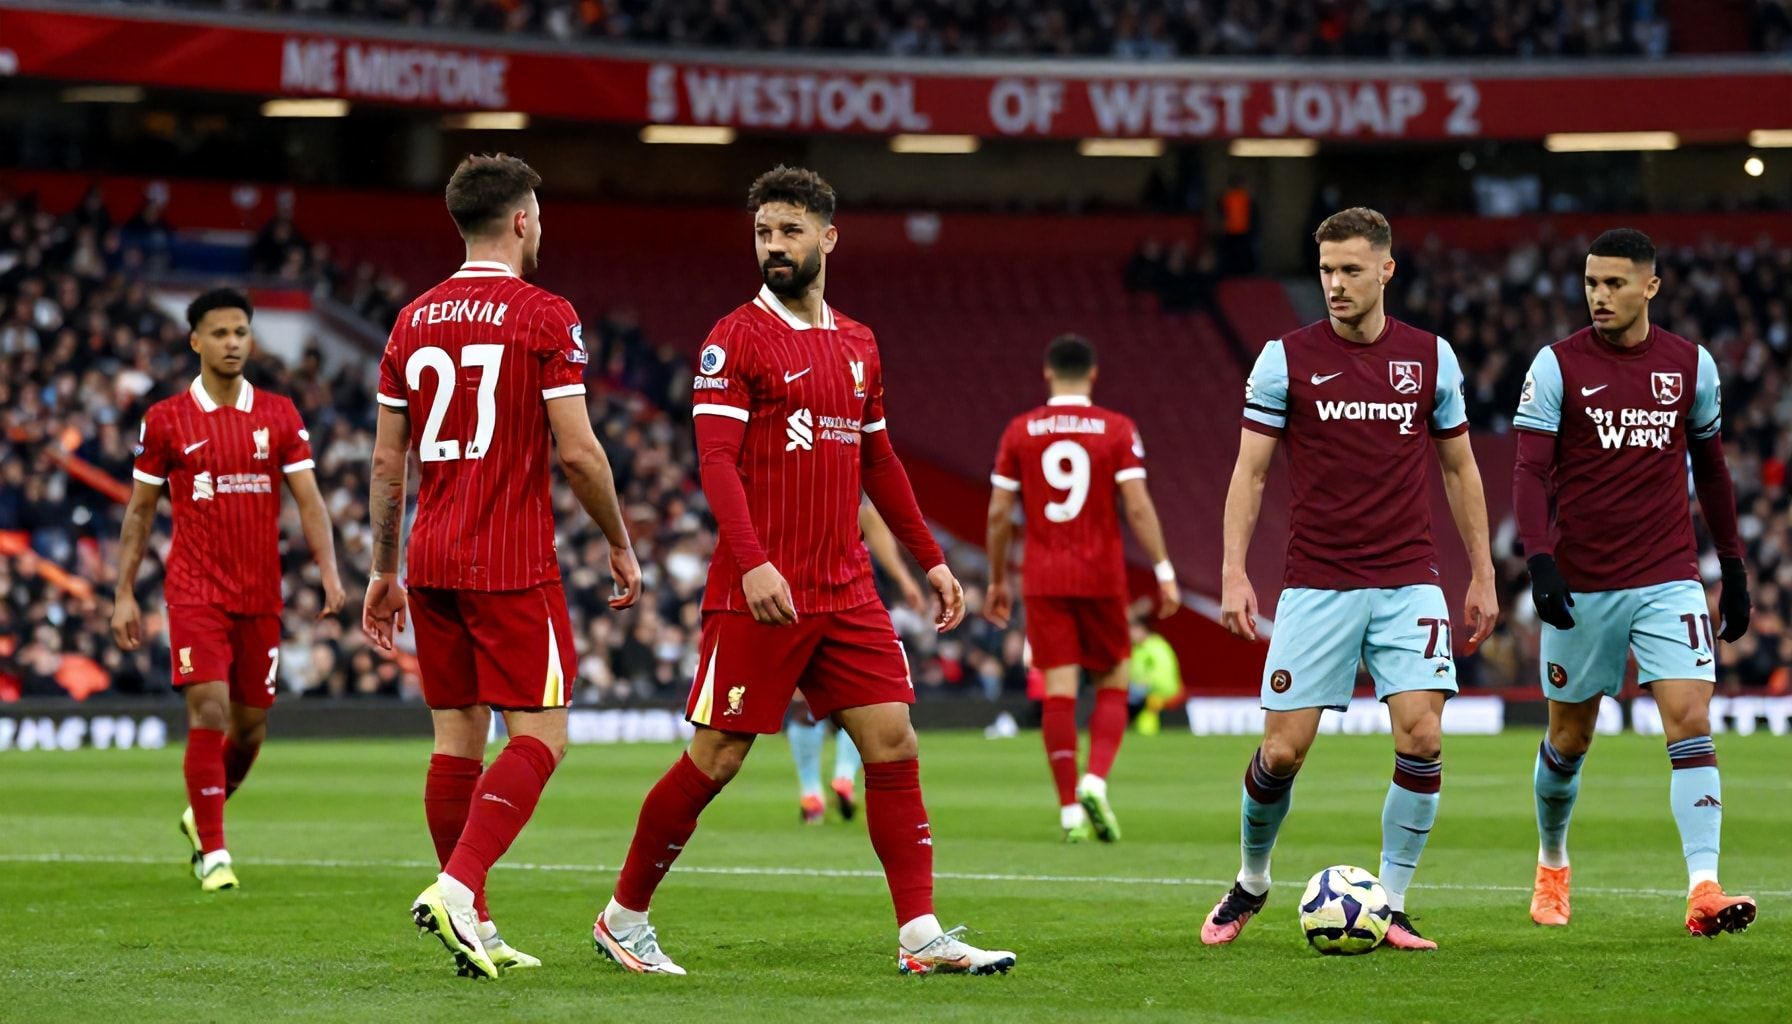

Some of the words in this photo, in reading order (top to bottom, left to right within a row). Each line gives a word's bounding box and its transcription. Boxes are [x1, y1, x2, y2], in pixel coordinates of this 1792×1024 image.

[988, 78, 1065, 135] OF
[1088, 80, 1248, 136] WEST
[405, 344, 505, 463] 27
[1041, 439, 1091, 523] 9
